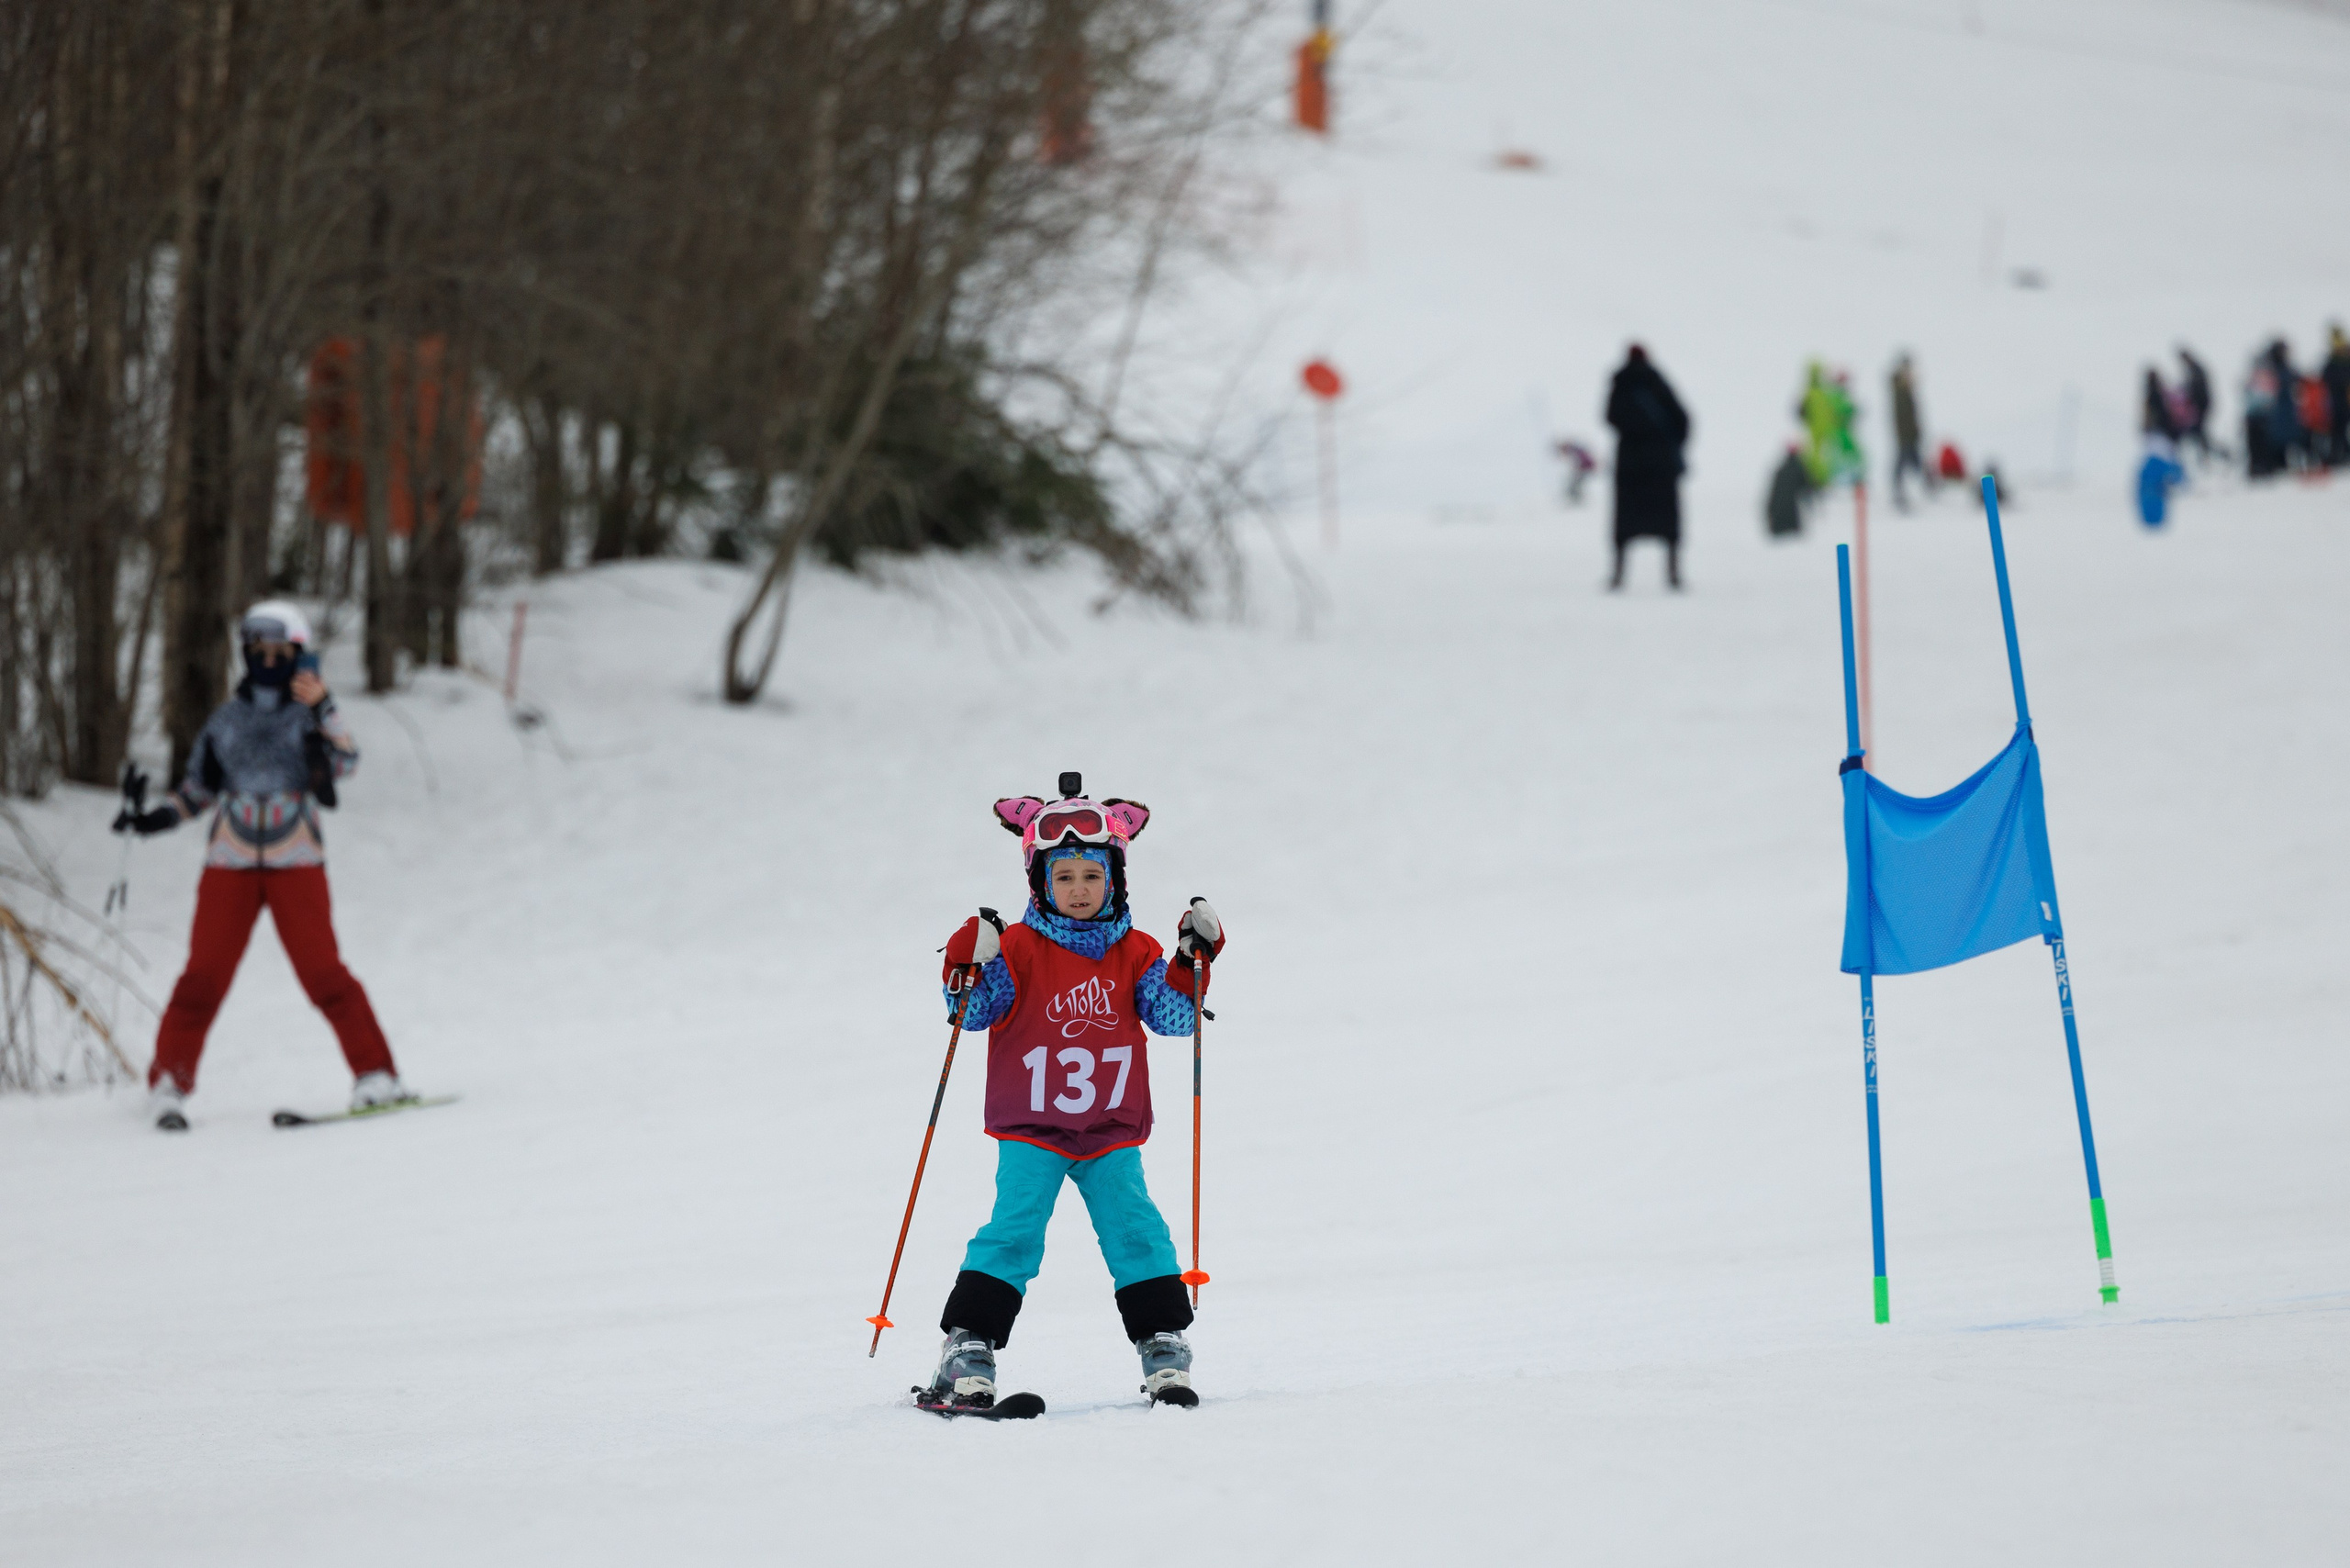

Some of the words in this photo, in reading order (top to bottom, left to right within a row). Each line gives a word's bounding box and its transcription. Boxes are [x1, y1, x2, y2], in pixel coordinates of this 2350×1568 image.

[2052, 939, 2068, 1001] ISKI
[1863, 1006, 1877, 1078] LISKI
[1022, 1045, 1133, 1114] 137
